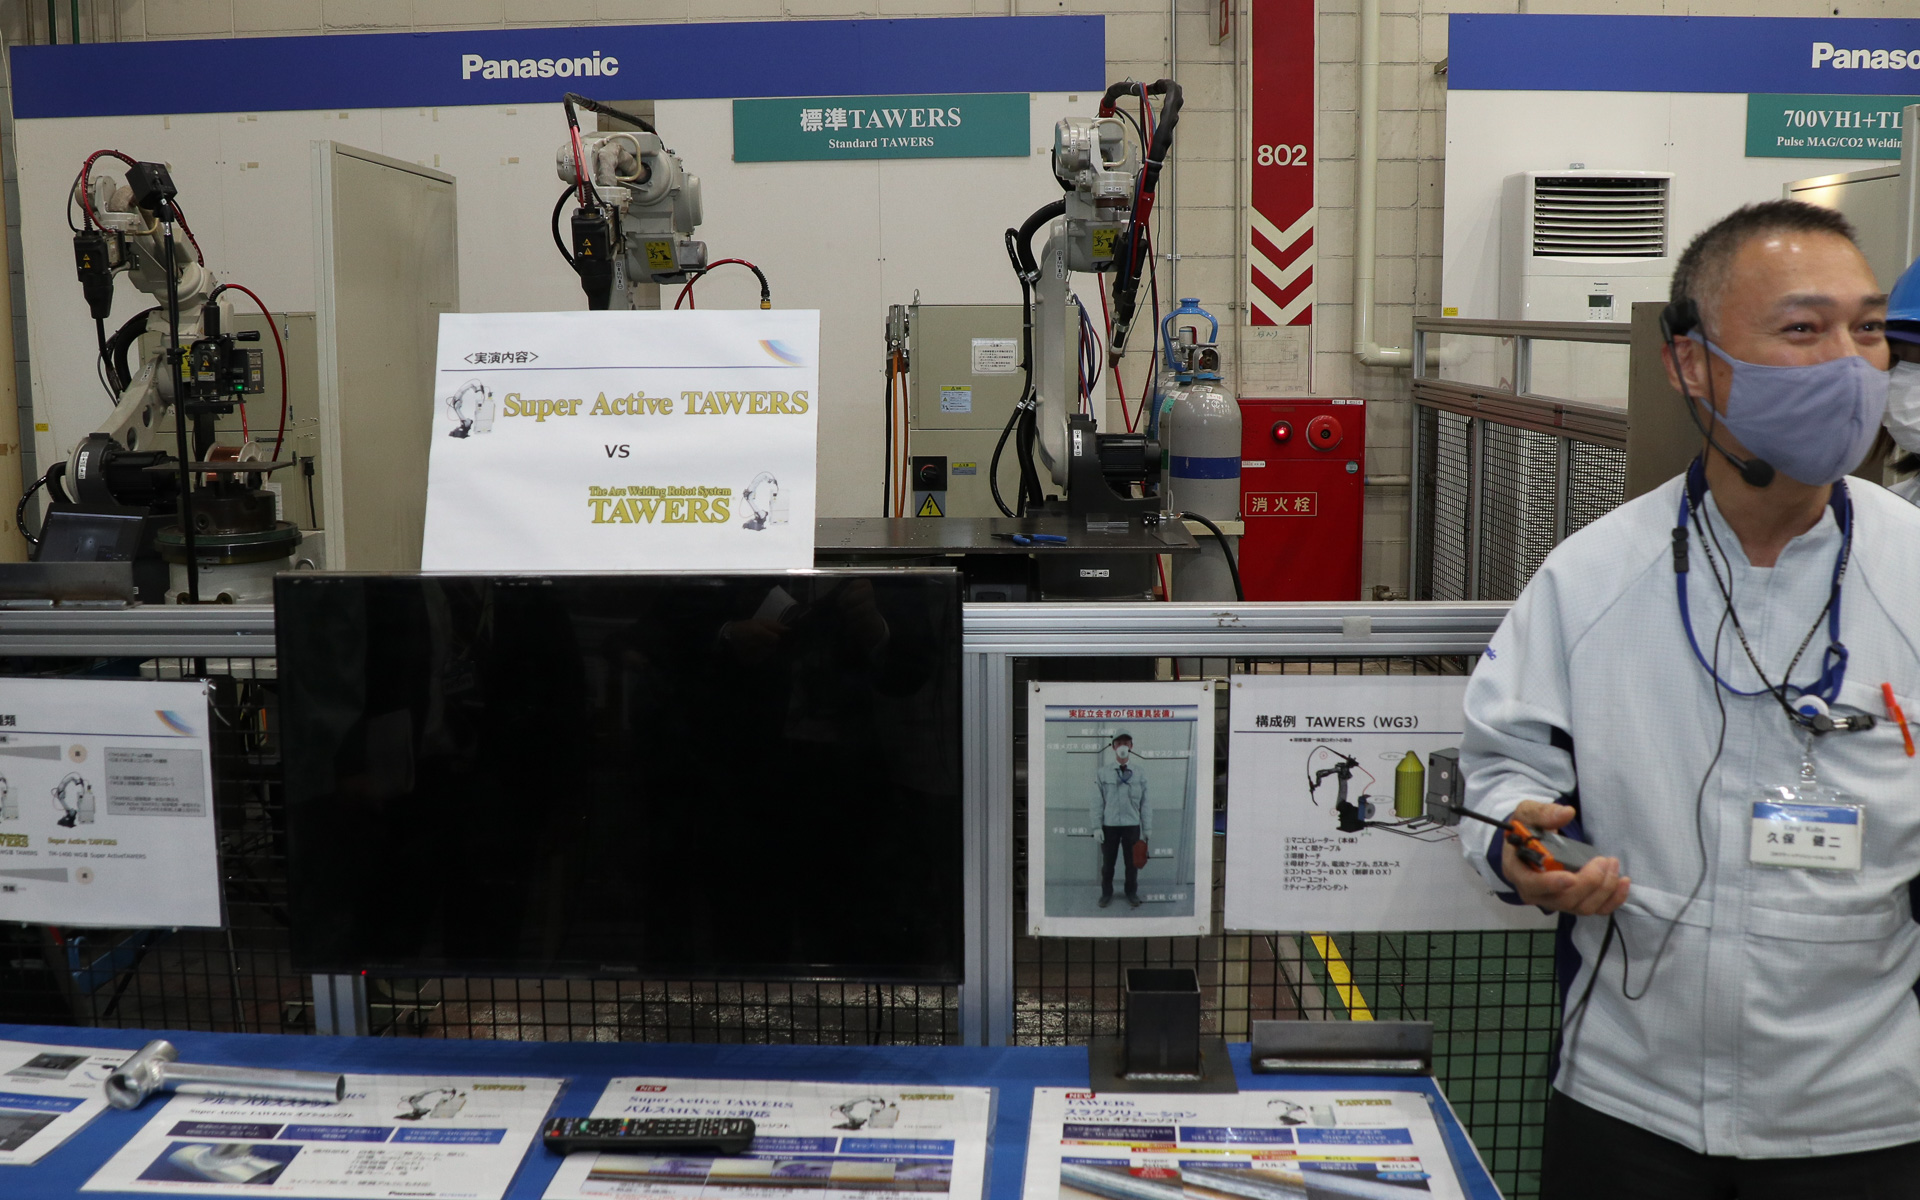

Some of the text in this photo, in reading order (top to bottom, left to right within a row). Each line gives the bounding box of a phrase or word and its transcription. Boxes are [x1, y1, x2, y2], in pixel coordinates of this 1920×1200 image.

[1811, 42, 1920, 70] Panaso
[461, 50, 619, 80] Panasonic
[800, 107, 962, 132] 標準TAWERS
[1783, 109, 1903, 129] 700VH1+TL
[828, 136, 934, 149] Standard TAWERS
[1776, 136, 1804, 147] Pulse
[1806, 136, 1863, 148] MAG/CO2
[1257, 144, 1308, 167] 802
[502, 390, 809, 422] Super Active TAWERS
[588, 486, 732, 499] The Arc Welding Robot System
[588, 498, 731, 524] TAWERS
[1251, 496, 1311, 513] 消火栓
[1069, 709, 1175, 719] 実証立会者の「保護具装備」
[1255, 715, 1296, 728] 構成例
[628, 1095, 794, 1108] Super Active TAWERS
[1066, 1099, 1135, 1107] TAWERS
[1065, 1107, 1198, 1119] スラグソリューション
